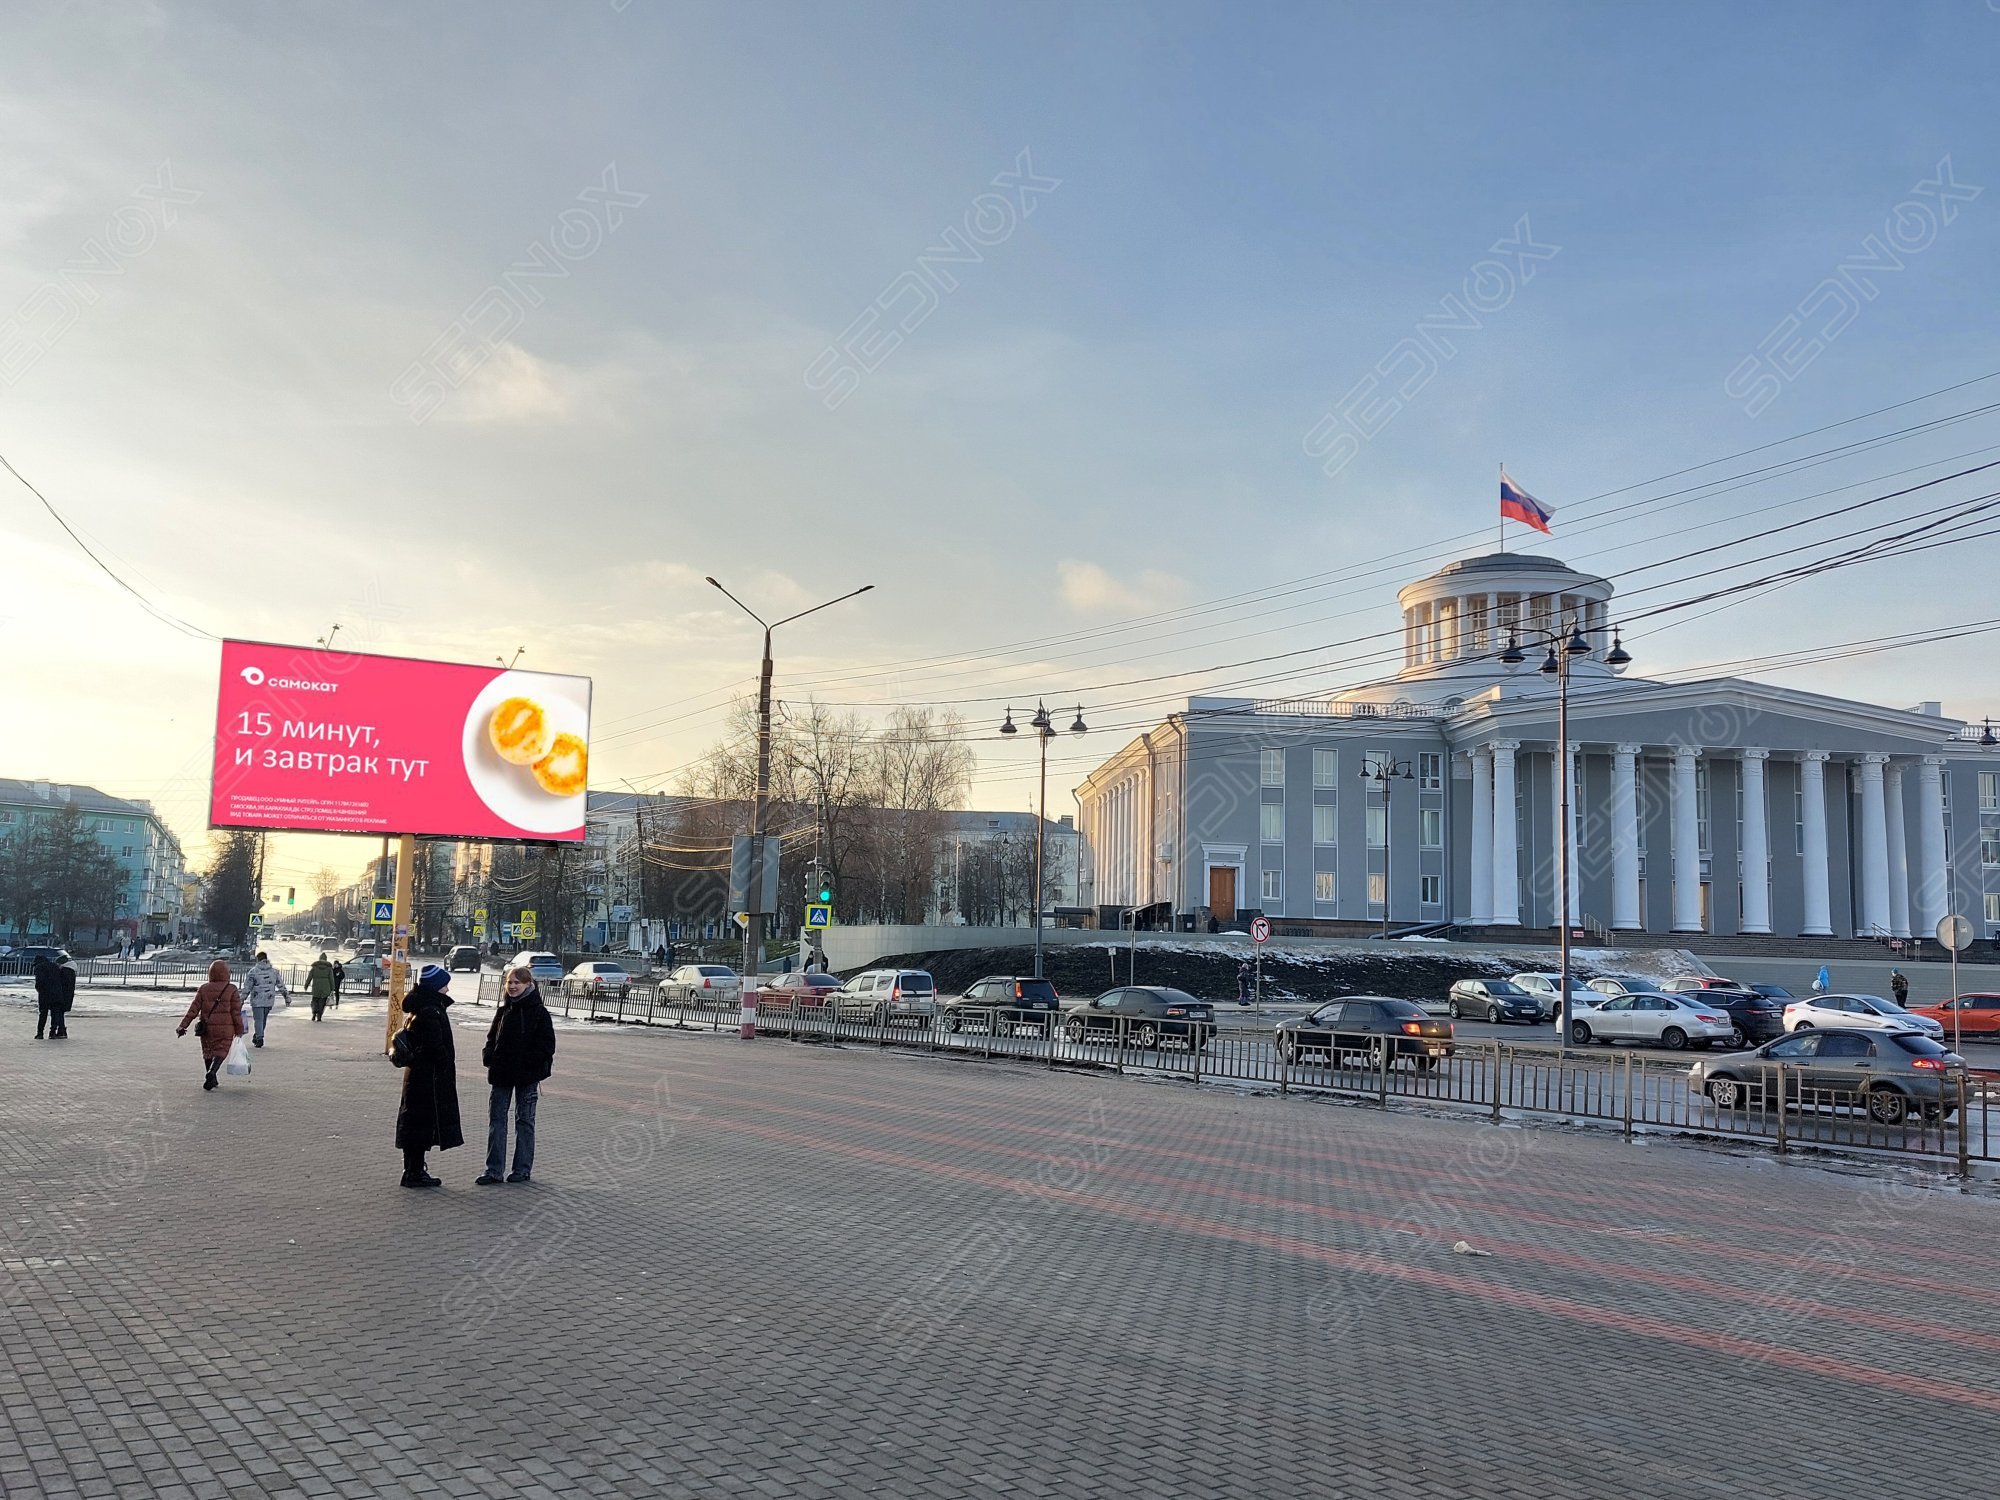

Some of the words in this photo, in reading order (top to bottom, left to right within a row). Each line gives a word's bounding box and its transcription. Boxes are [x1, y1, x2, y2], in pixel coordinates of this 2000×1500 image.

[268, 676, 339, 693] самокат
[237, 711, 272, 736] 15
[282, 719, 380, 748] минут,
[234, 749, 252, 766] и
[262, 750, 379, 776] завтрак
[387, 756, 429, 782] тут
